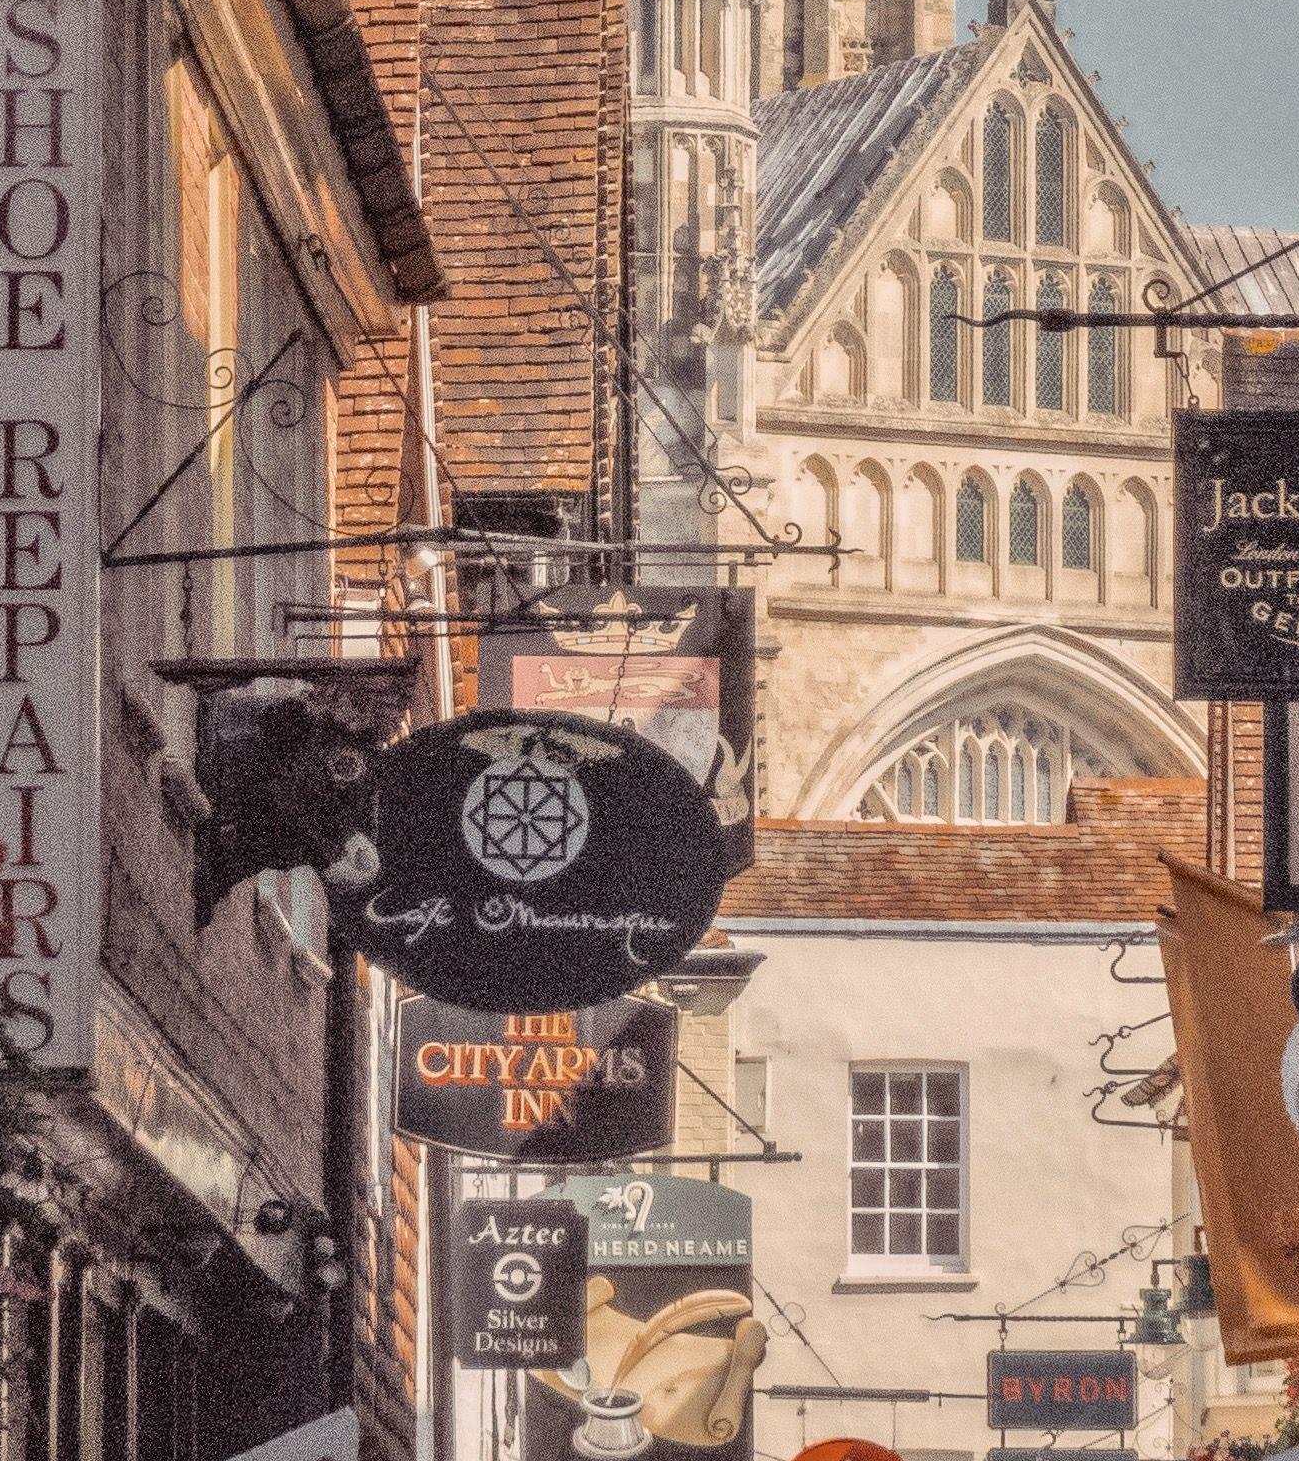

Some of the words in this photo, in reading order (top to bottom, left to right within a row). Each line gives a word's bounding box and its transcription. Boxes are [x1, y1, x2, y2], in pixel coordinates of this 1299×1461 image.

[475, 894, 678, 965] Mauresque
[416, 1040, 524, 1087] CITY
[524, 1044, 647, 1087] ARMS
[502, 1087, 574, 1130] INN
[468, 1214, 566, 1245] Aztec
[665, 1239, 749, 1257] NEAME
[486, 1309, 549, 1331] Silver
[473, 1332, 559, 1358] Designs
[1002, 1376, 1129, 1403] BYRON
